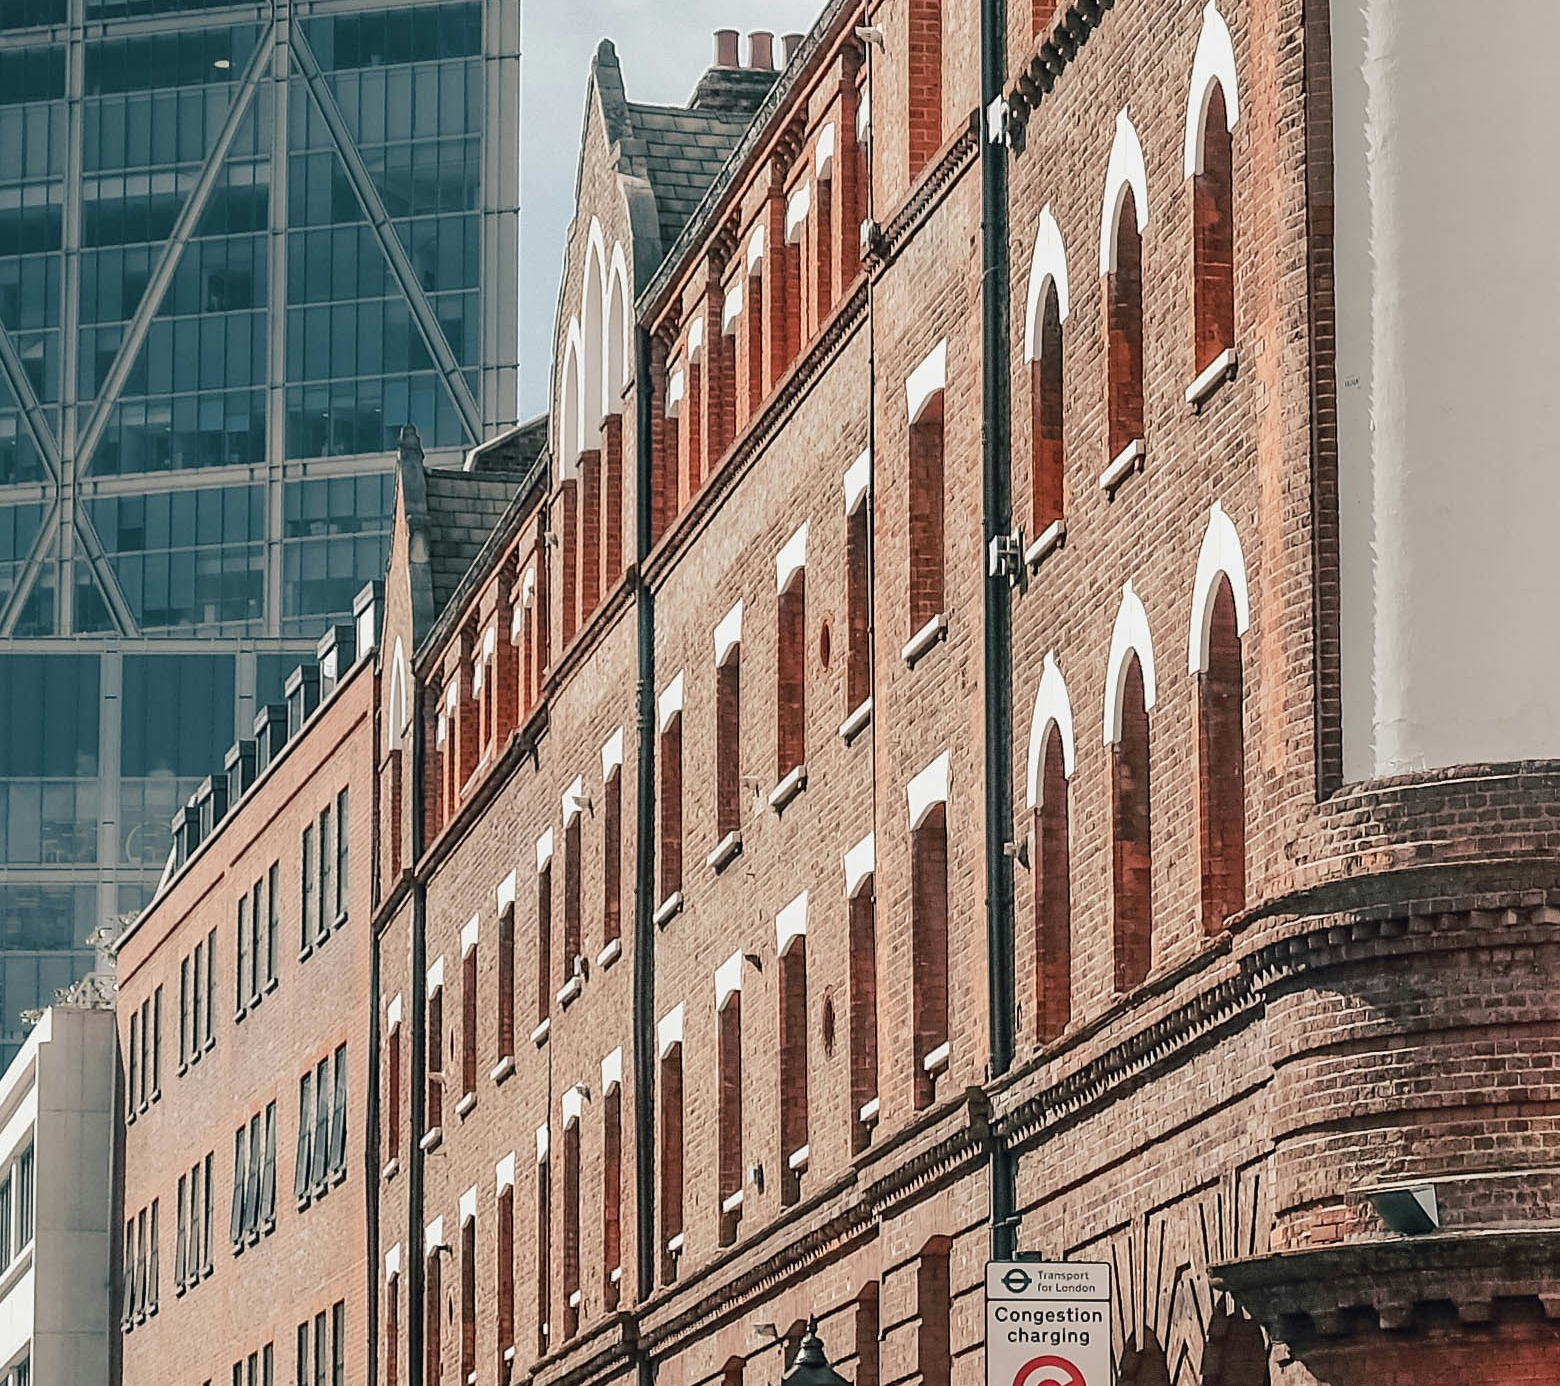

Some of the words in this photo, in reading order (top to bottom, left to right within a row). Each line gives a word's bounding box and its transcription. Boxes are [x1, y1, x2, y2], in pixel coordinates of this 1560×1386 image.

[1038, 1270, 1089, 1281] Transport
[1037, 1283, 1052, 1292] for
[1055, 1283, 1096, 1293] London
[994, 1306, 1103, 1326] Congestion
[1007, 1327, 1090, 1346] charging
